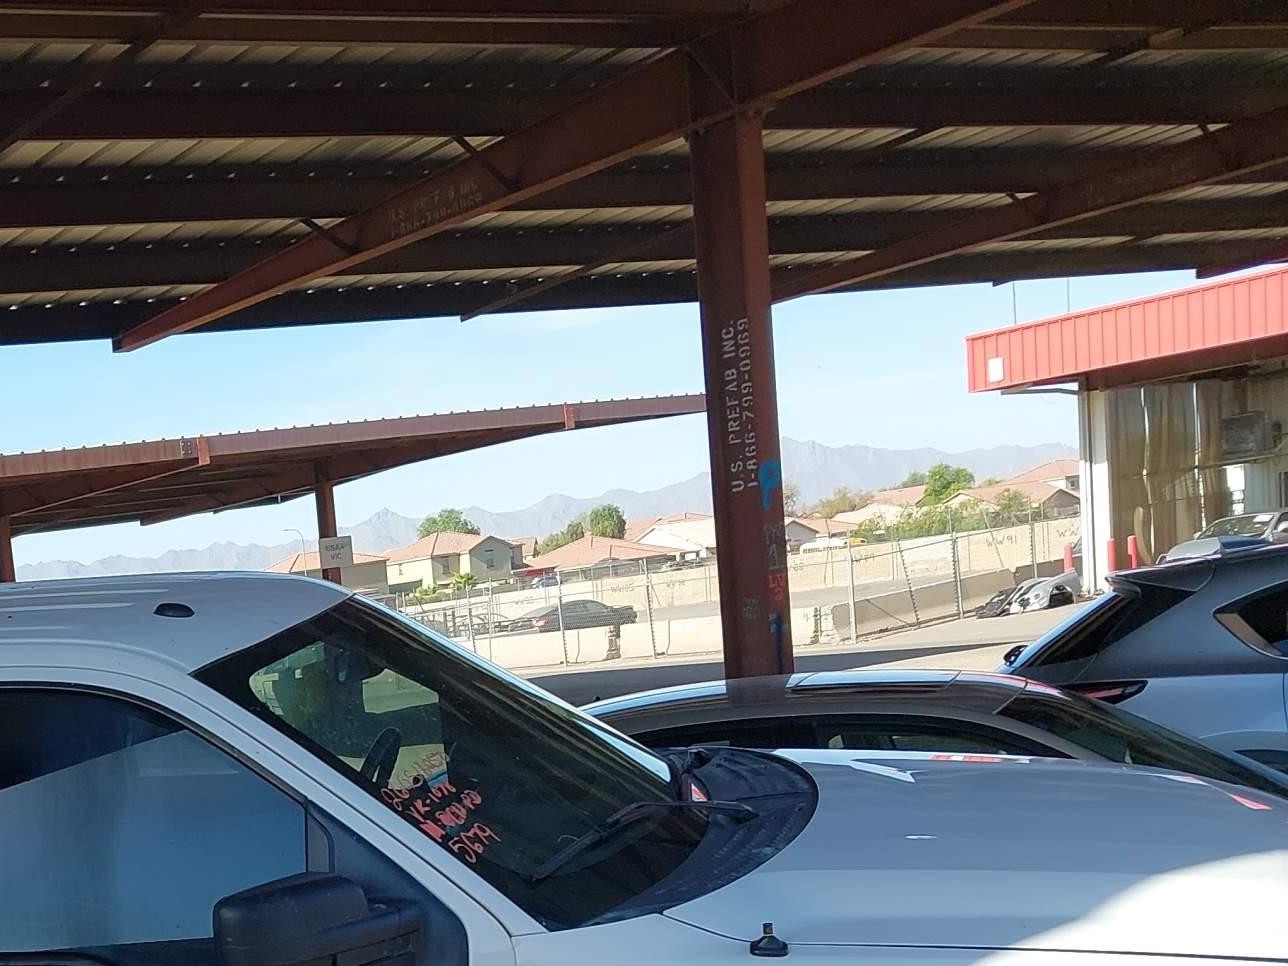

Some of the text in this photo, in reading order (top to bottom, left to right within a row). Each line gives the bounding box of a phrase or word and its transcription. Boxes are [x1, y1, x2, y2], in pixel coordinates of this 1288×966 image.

[721, 319, 745, 493] U.S. PREFAB INC.
[737, 317, 759, 488] 1-866-799-0969
